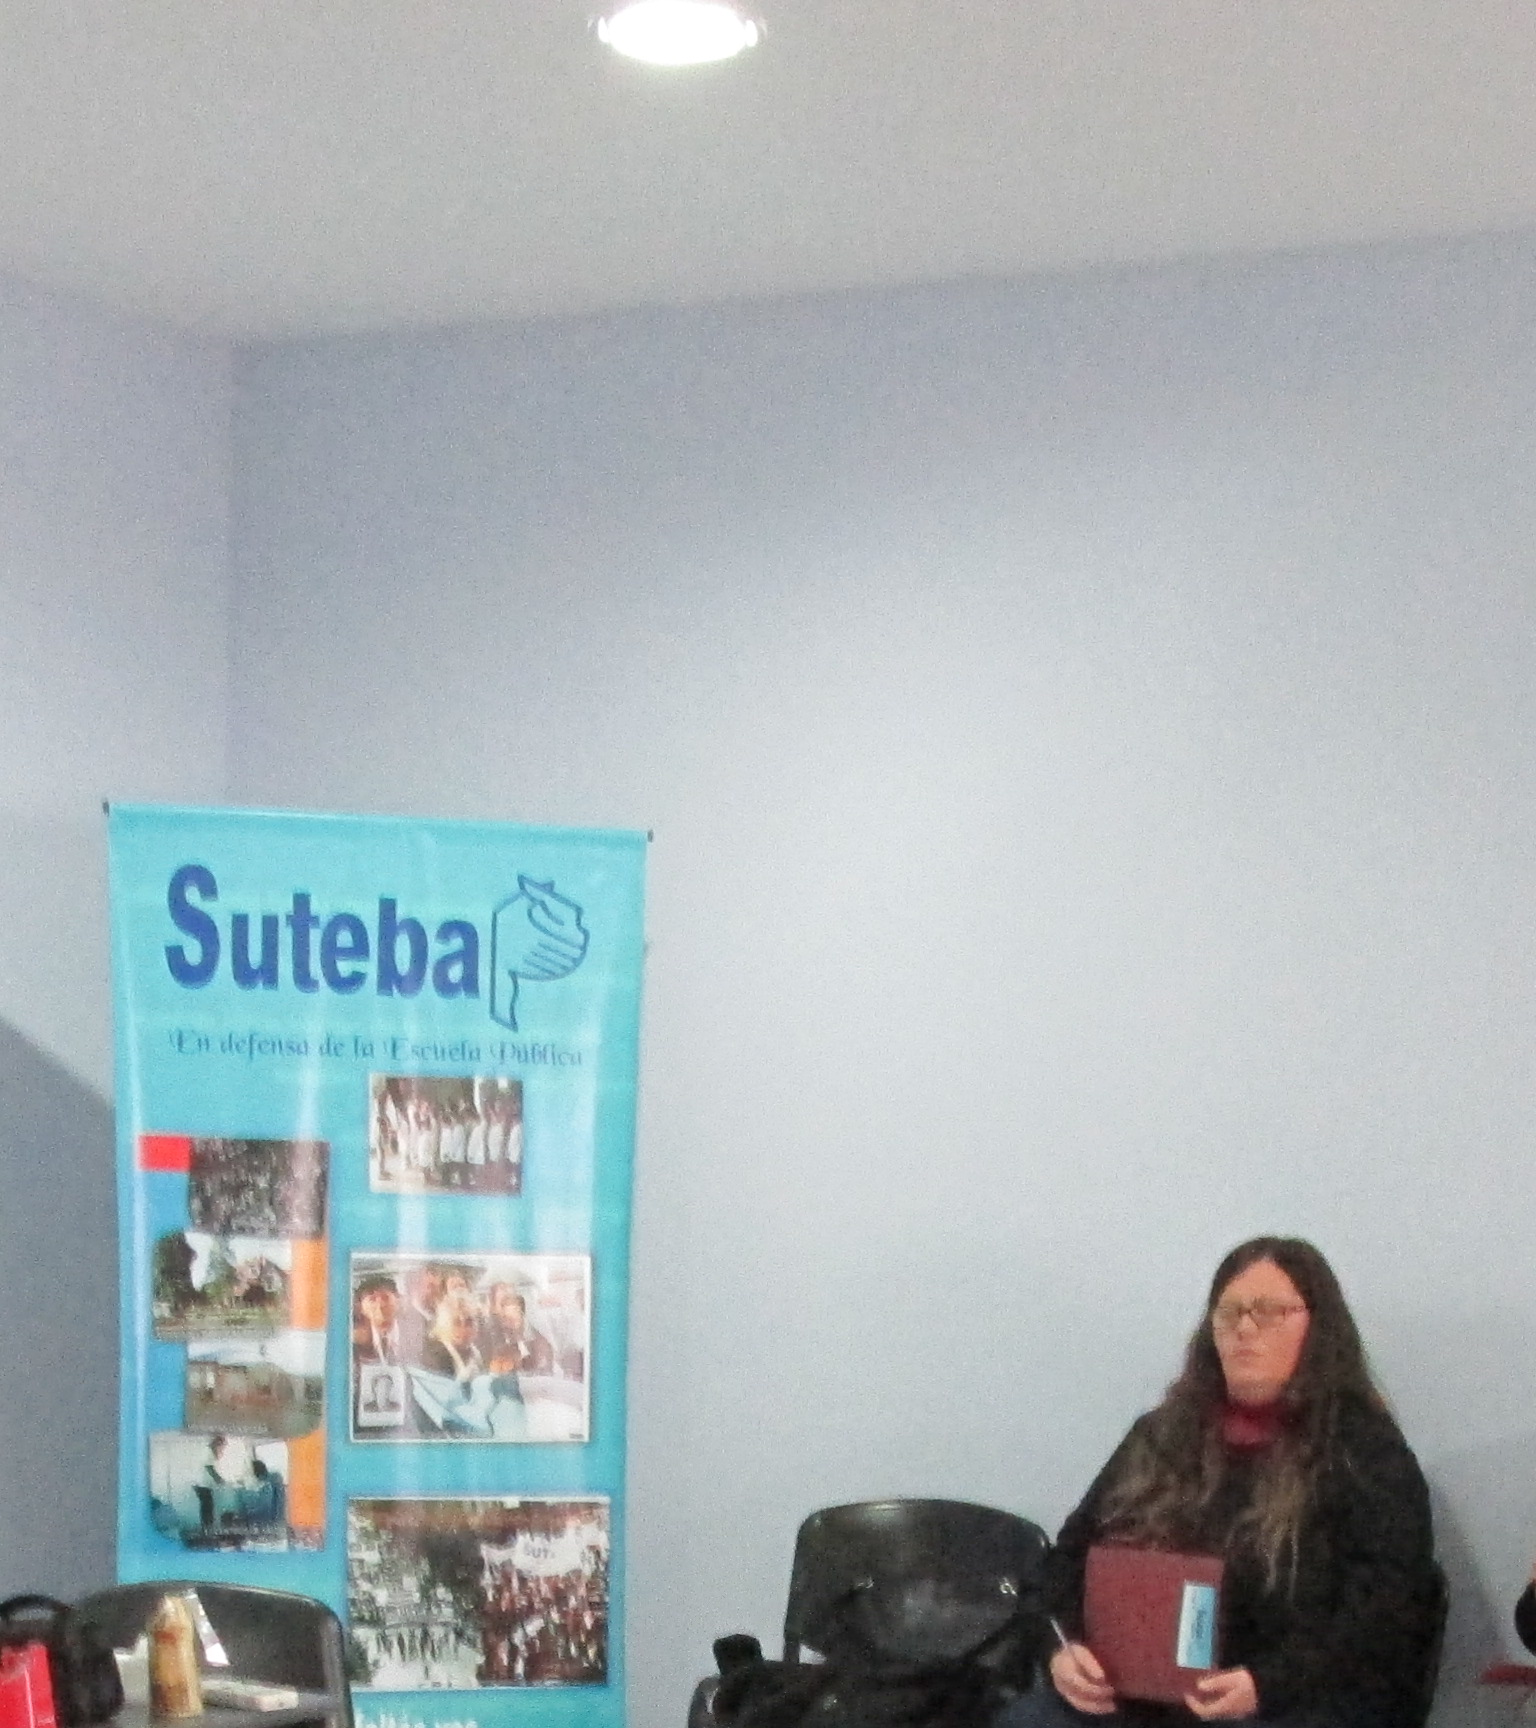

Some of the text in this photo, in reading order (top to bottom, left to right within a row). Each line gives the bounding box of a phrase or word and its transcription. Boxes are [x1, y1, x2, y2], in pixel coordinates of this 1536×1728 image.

[164, 863, 481, 998] Suteba
[220, 1031, 309, 1063] defensa
[319, 1031, 345, 1058] de
[354, 1034, 375, 1060] la
[382, 1036, 482, 1062] Escuela
